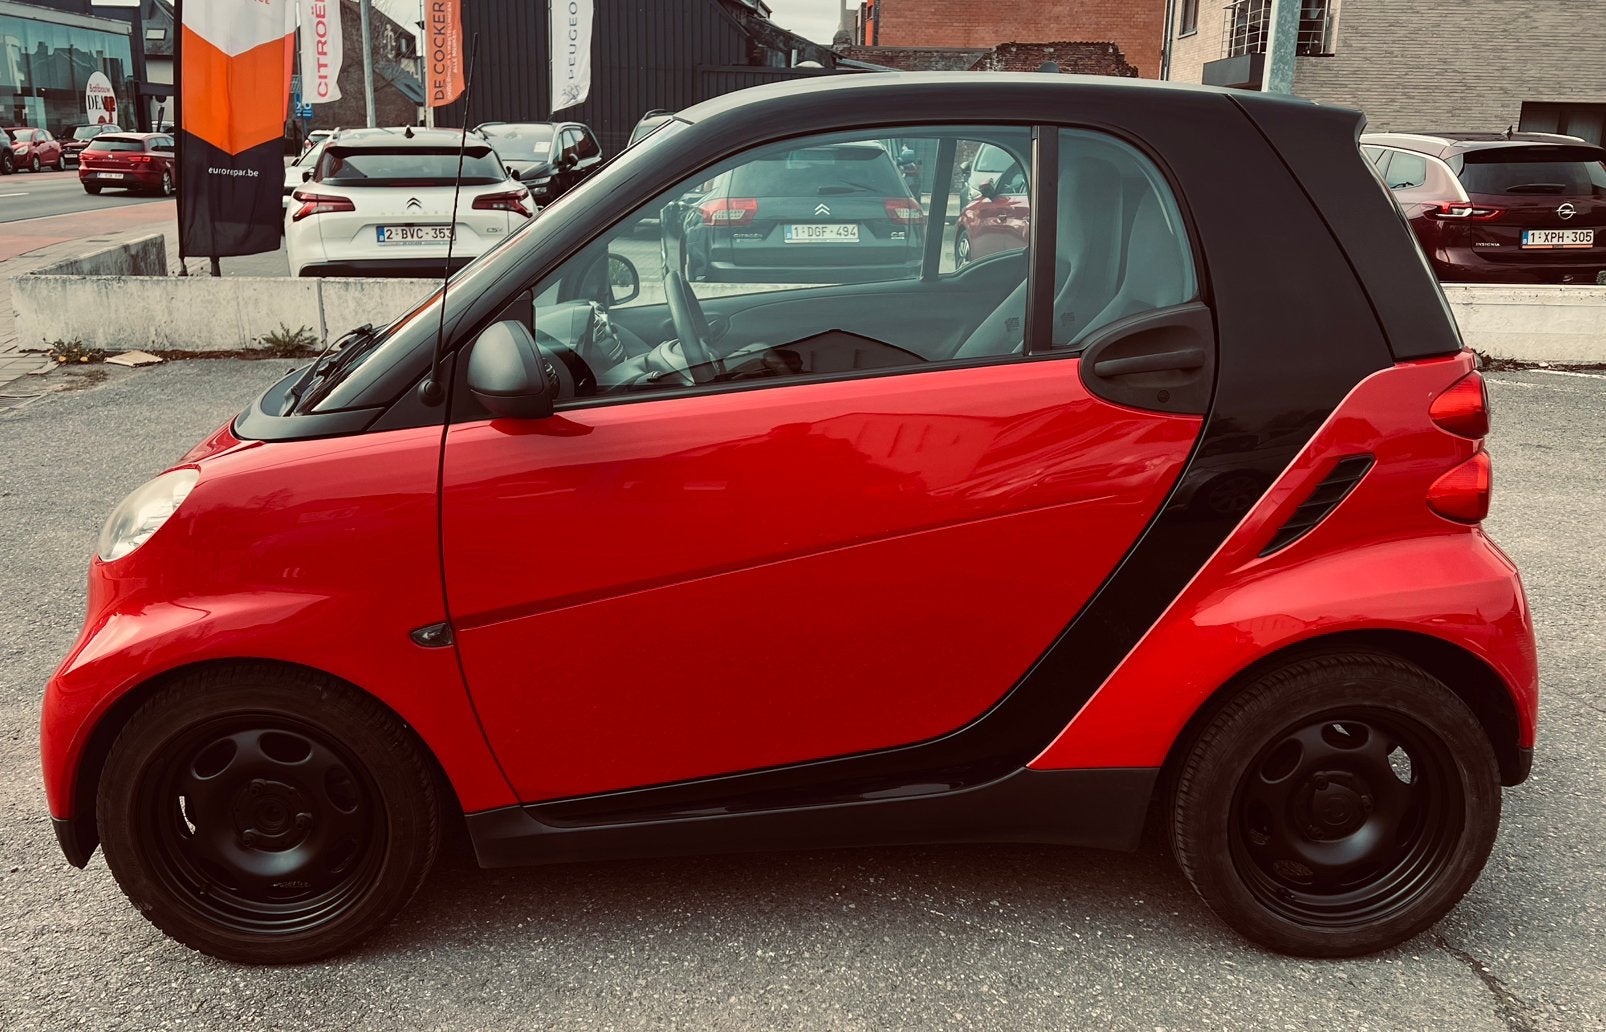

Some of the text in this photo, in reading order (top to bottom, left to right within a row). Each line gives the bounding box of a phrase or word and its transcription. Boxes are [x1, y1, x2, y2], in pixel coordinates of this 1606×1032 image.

[311, 0, 328, 97] CITROË
[433, 2, 446, 100] DE COCKER
[208, 167, 259, 177] eurorepar.be
